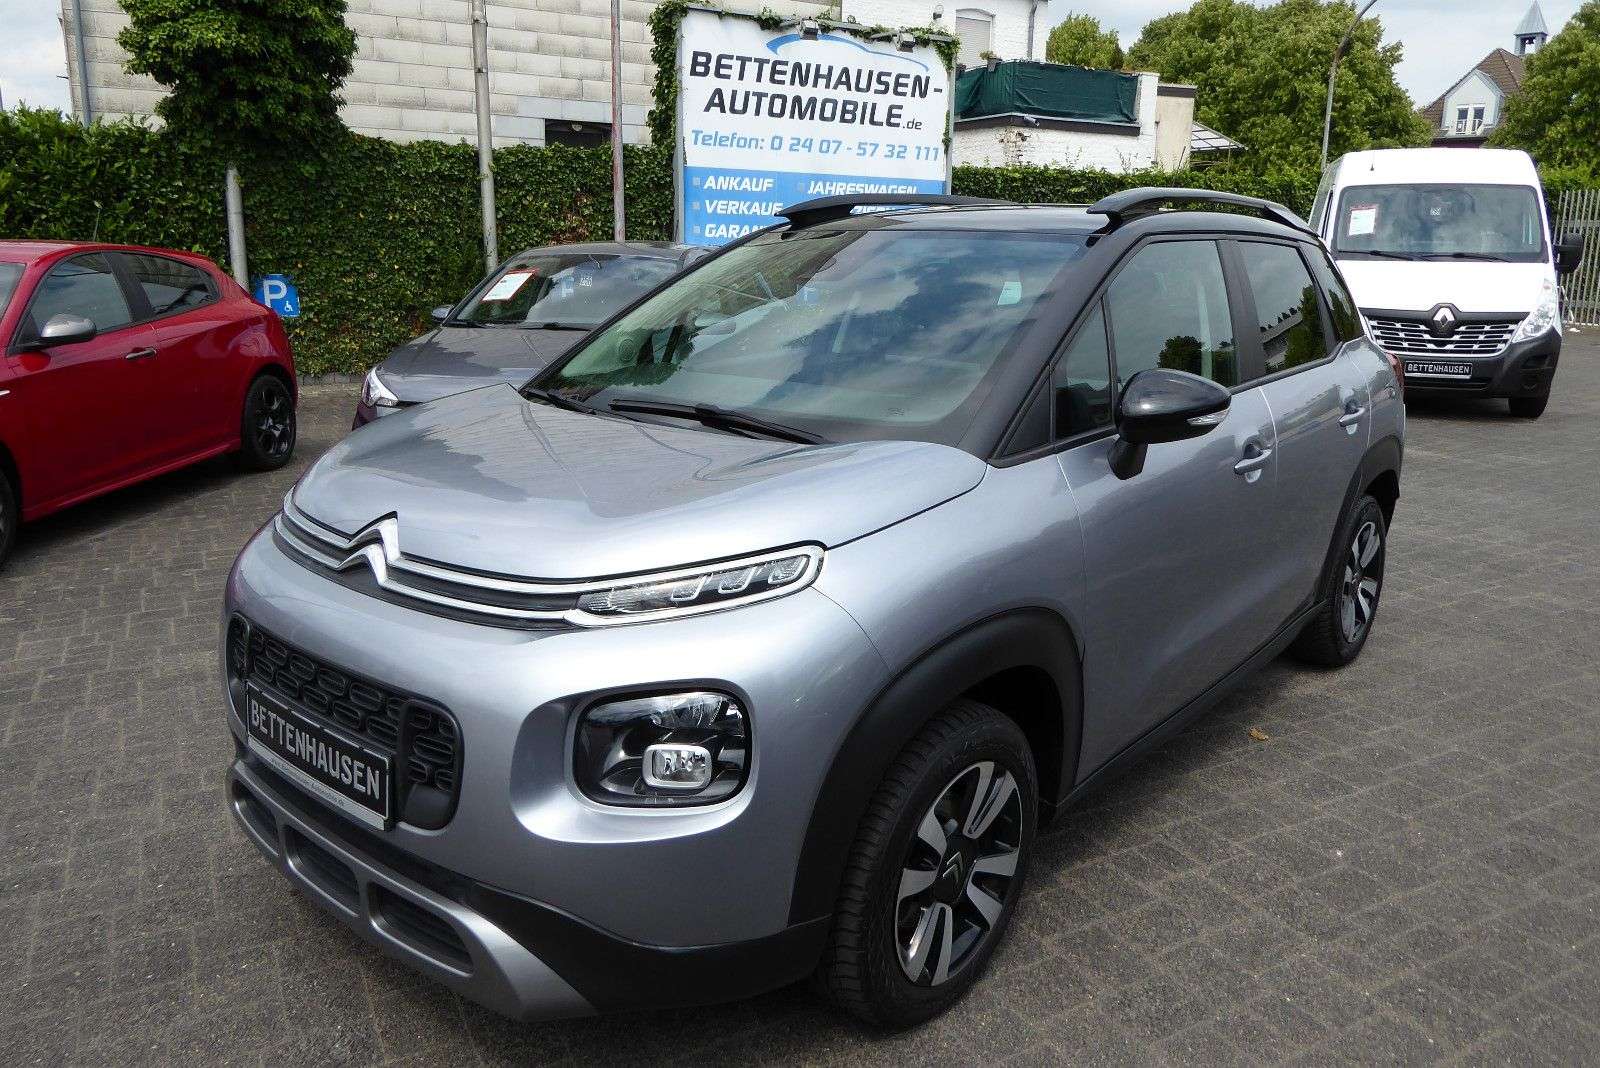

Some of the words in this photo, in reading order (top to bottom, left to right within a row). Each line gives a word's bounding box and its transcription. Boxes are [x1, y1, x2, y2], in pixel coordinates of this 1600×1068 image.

[689, 50, 943, 99] BETTENHAUSEN-
[691, 129, 765, 150] Telefon:
[790, 137, 813, 153] 24
[818, 138, 841, 155] 07
[856, 141, 878, 158] 57
[883, 143, 907, 160] 32
[915, 145, 939, 162] 111
[703, 175, 775, 193] ANKAUF
[704, 199, 784, 216] VERKAUF
[263, 279, 287, 308] P
[1407, 363, 1470, 374] BETTENHAUSEN
[251, 700, 380, 800] BETTENHAUSEN
